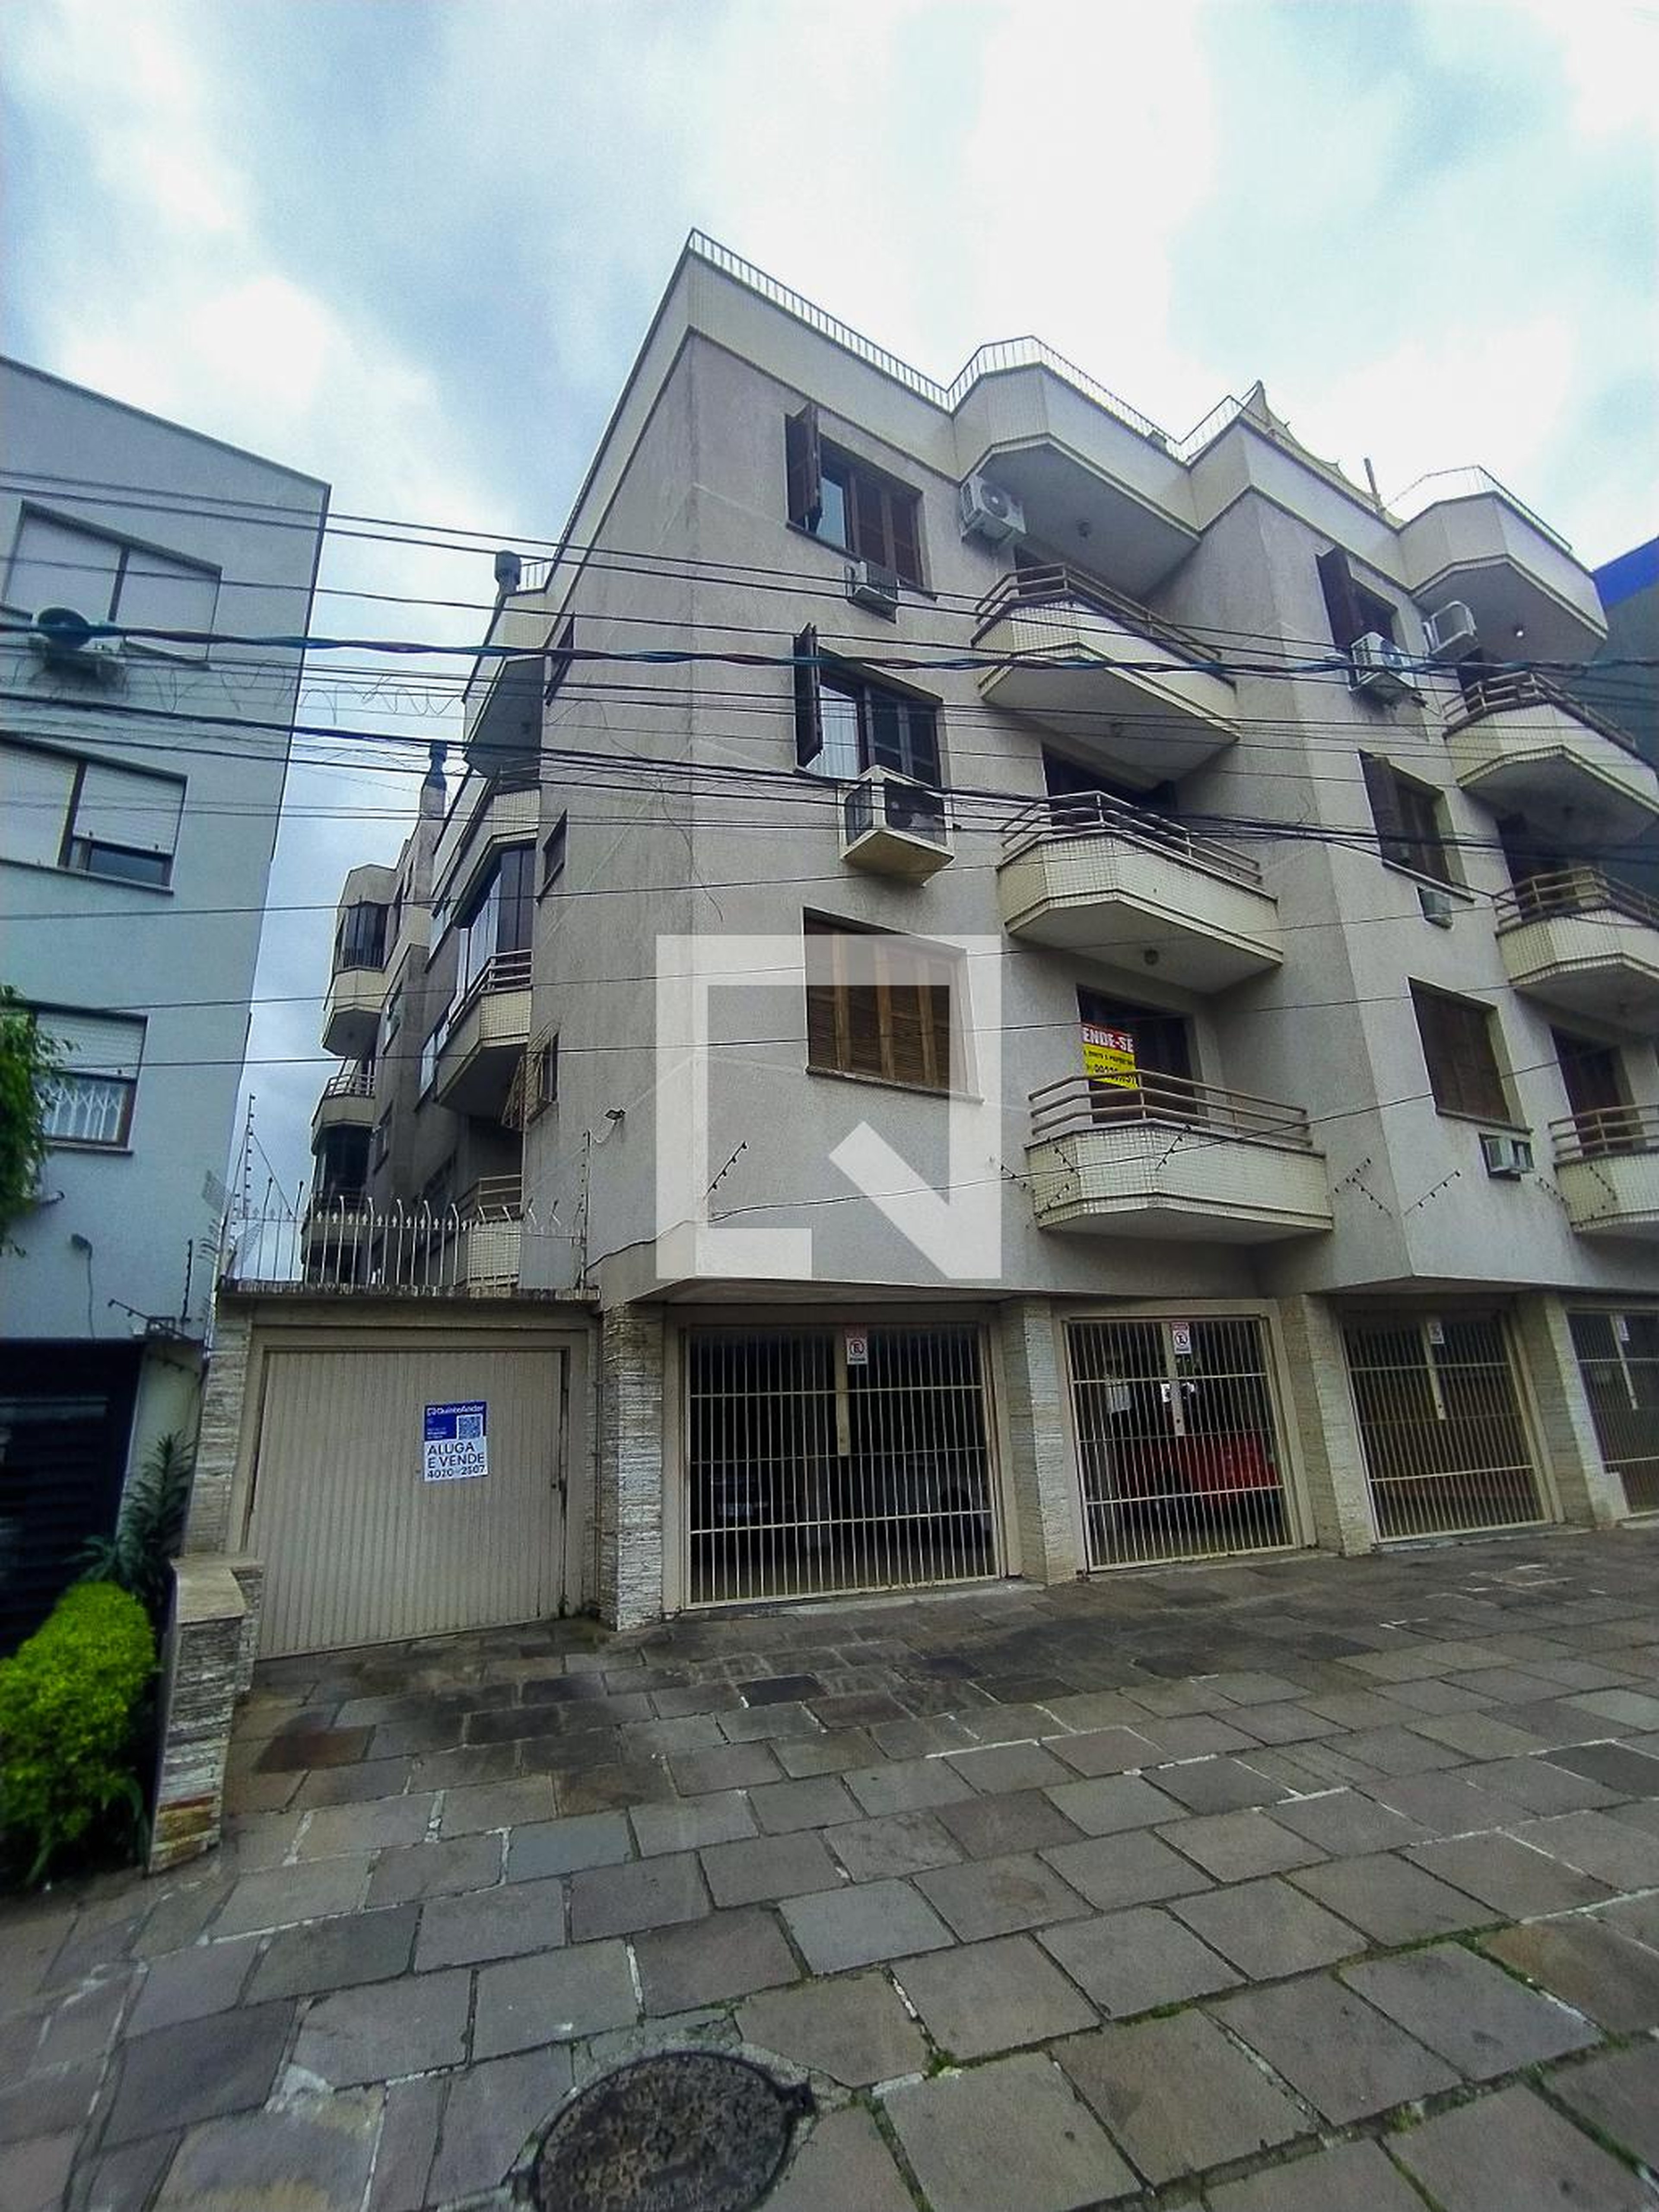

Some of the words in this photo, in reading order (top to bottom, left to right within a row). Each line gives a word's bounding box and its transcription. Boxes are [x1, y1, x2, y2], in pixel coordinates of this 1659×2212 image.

[1082, 1028, 1133, 1053] ENDE-SE
[428, 1442, 475, 1455] ALUGA
[428, 1457, 435, 1468] E
[439, 1452, 484, 1467] VENDE
